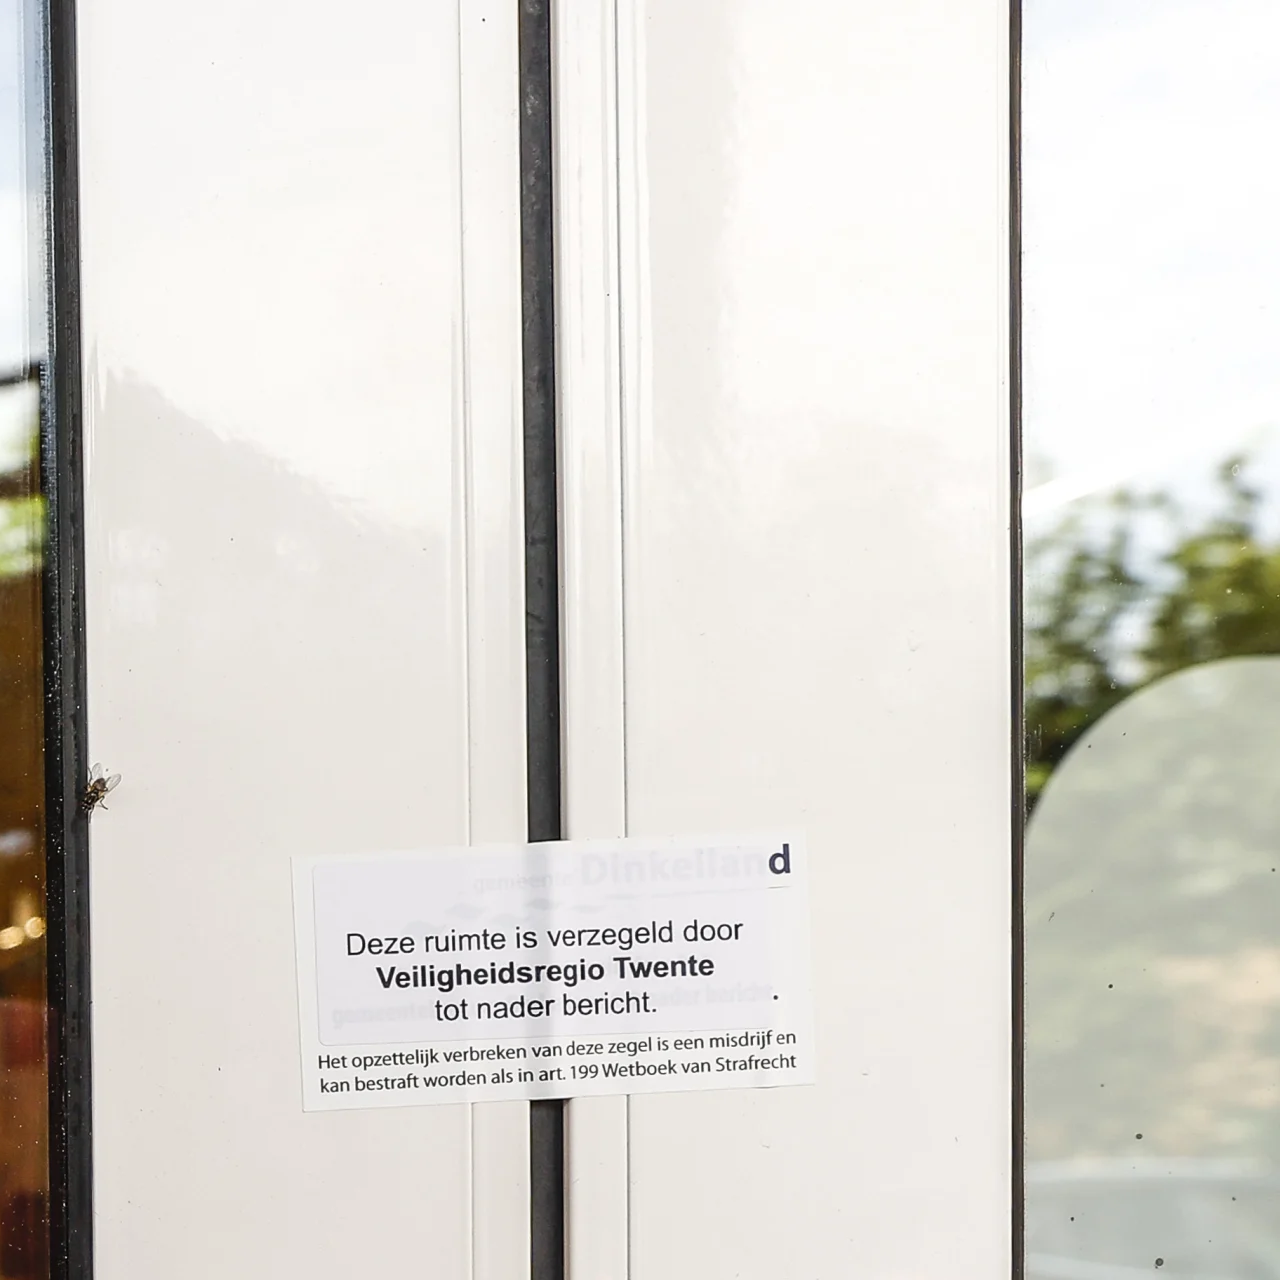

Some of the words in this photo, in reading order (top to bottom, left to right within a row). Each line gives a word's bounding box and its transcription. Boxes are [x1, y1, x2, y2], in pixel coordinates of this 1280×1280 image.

[347, 933, 415, 955] Deze
[425, 929, 506, 952] ruimte
[516, 926, 537, 949] is
[547, 920, 673, 950] verzegeld
[683, 919, 743, 942] door
[376, 958, 604, 992] Veiligheidsregio
[613, 955, 714, 979] Twente
[435, 999, 468, 1021] tot
[478, 995, 555, 1019] nader
[563, 991, 656, 1016] bericht.
[318, 1055, 348, 1069] Het
[352, 1048, 439, 1071] opzettelijk
[443, 1045, 527, 1062] verbreken
[531, 1046, 562, 1057] van
[566, 1041, 603, 1056] deze
[608, 1037, 652, 1056] zegel
[657, 1037, 669, 1051] is
[674, 1038, 704, 1050] een
[710, 1030, 772, 1050] misdrijf
[776, 1033, 796, 1044] en
[320, 1078, 350, 1093] kan
[354, 1074, 419, 1092] bestraft
[424, 1071, 487, 1088] worden
[491, 1069, 513, 1084] als
[517, 1068, 534, 1083] in
[538, 1066, 566, 1082] art.
[570, 1063, 599, 1080] 199
[601, 1059, 678, 1079] Wetboek
[681, 1060, 711, 1074] van
[715, 1053, 797, 1072] Strafrecht
